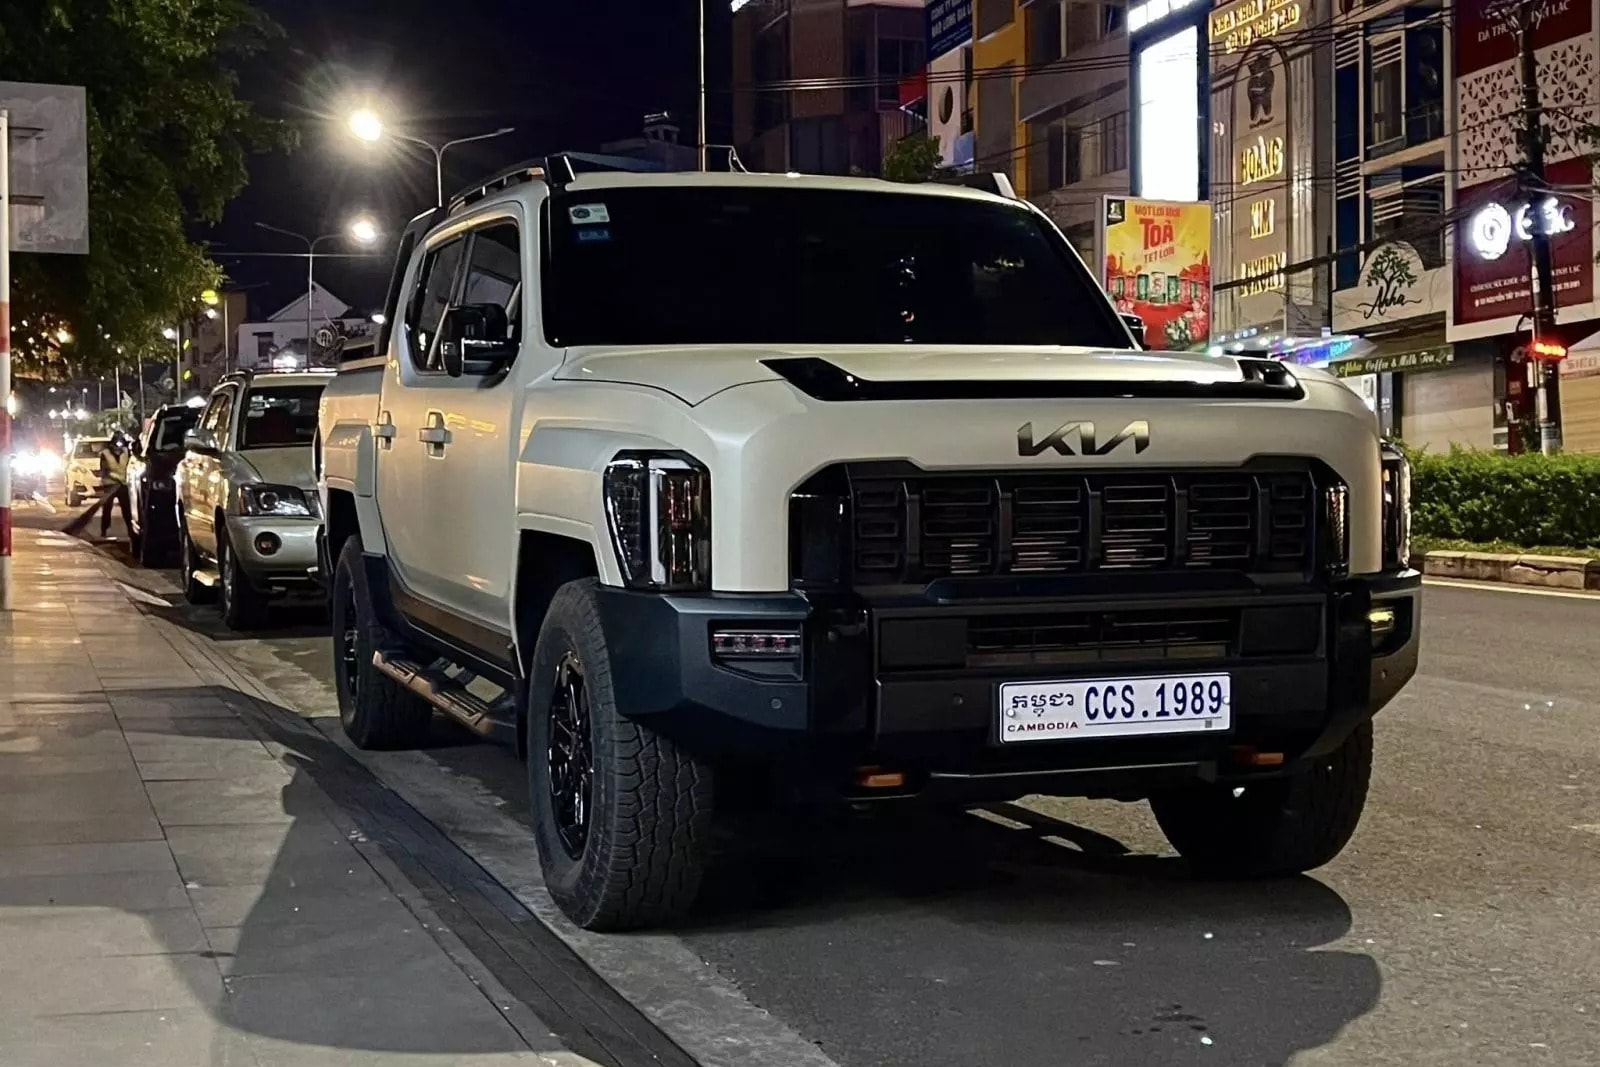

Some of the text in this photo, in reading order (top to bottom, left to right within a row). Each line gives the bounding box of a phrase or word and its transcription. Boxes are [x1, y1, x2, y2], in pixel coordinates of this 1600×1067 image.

[1250, 199, 1274, 239] KIM
[1017, 420, 1150, 456] KIA
[1085, 680, 1223, 721] CCS.1989
[1007, 721, 1079, 733] CAMBODIA
